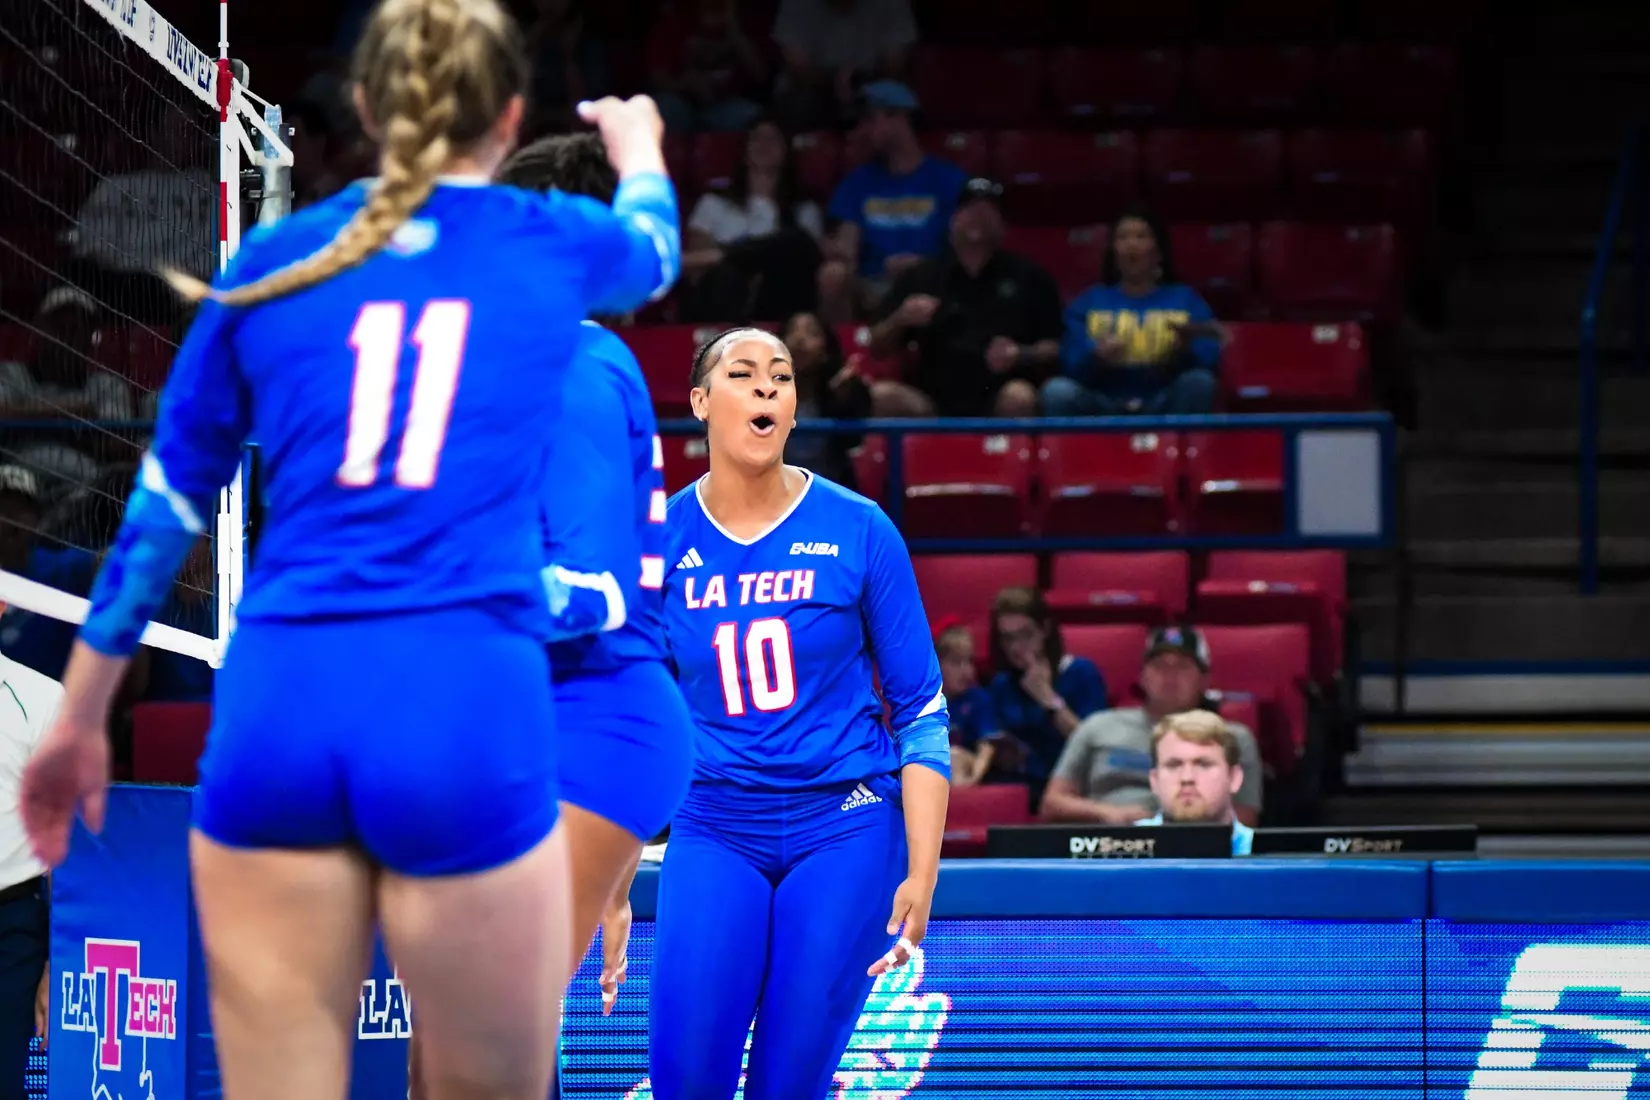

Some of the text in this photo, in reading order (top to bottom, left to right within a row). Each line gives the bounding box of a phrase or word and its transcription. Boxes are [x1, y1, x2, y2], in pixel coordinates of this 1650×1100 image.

[335, 298, 471, 488] 11
[685, 569, 815, 609] LA TECH
[712, 616, 796, 717] 10
[841, 795, 883, 812] adidas
[358, 978, 412, 1040] LA
